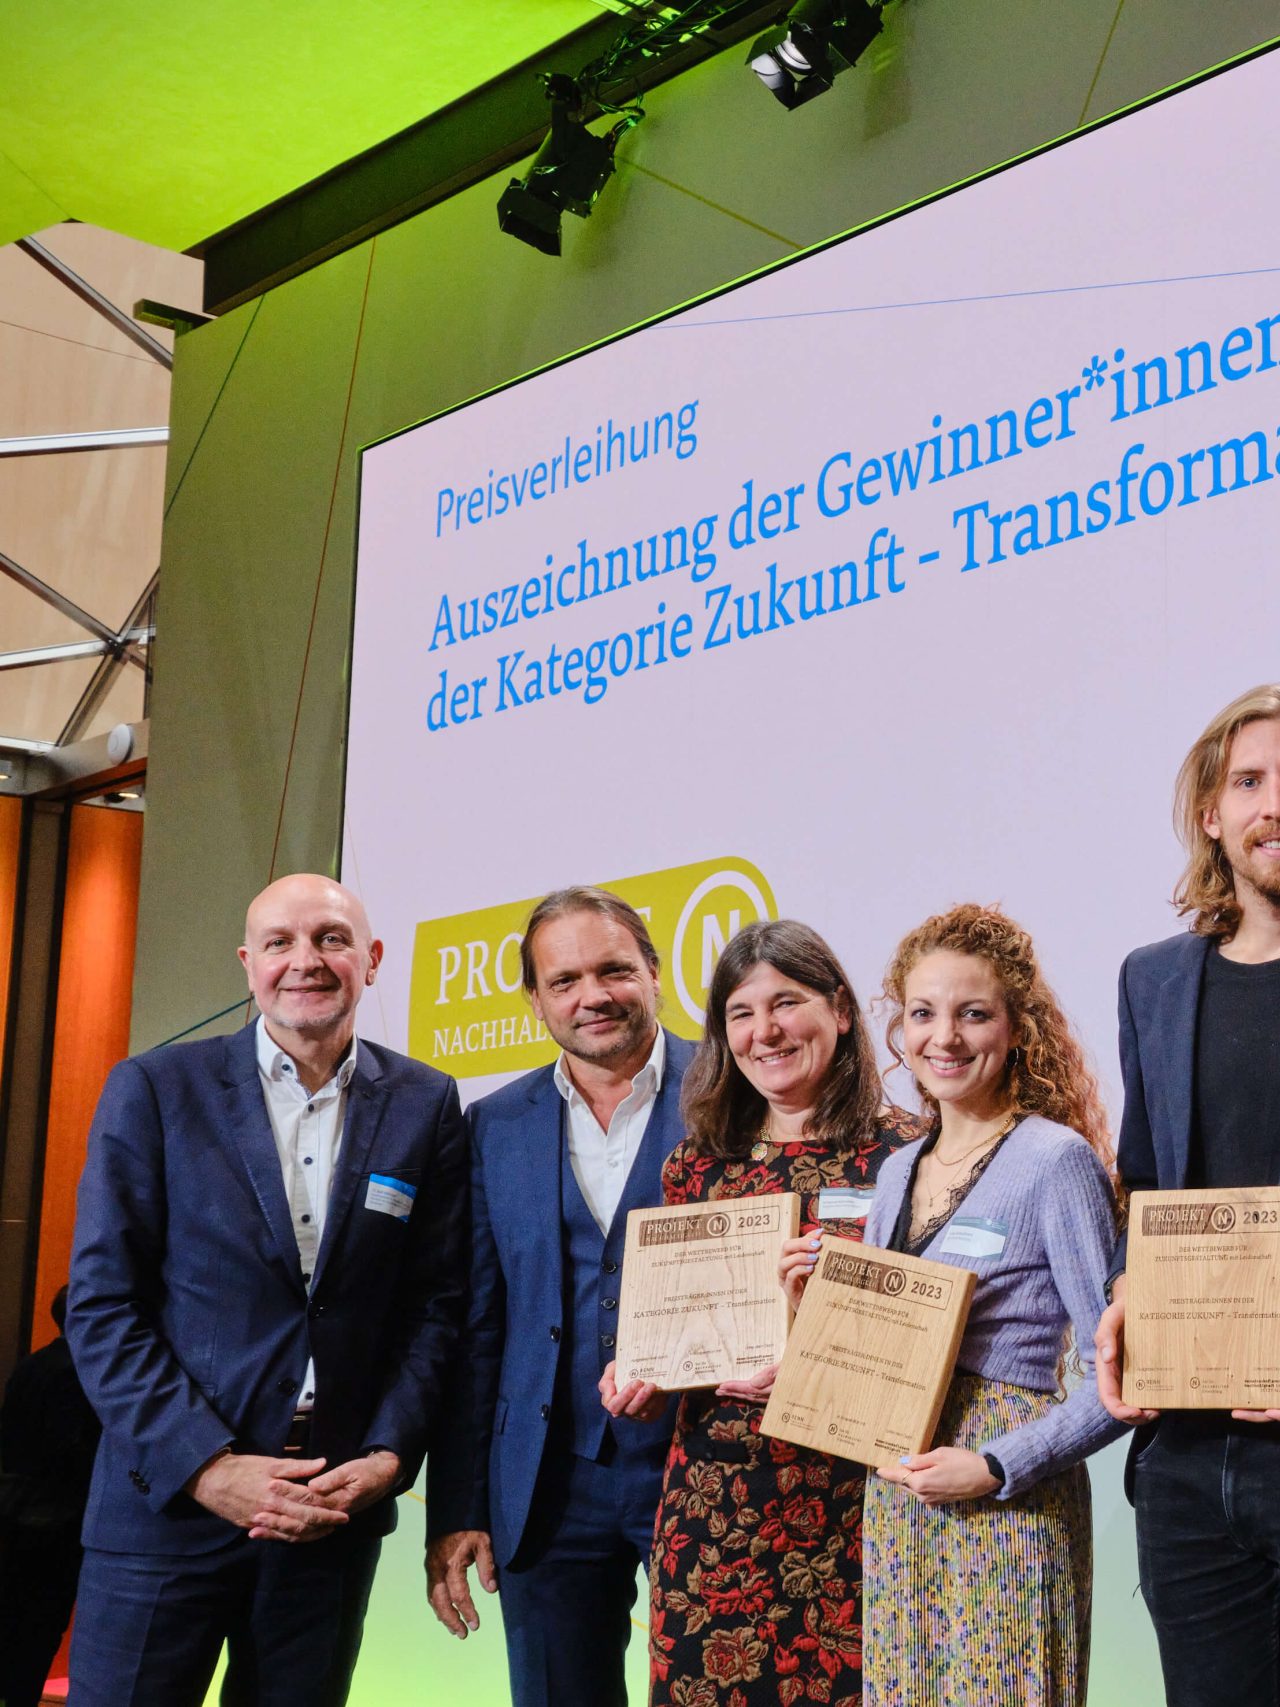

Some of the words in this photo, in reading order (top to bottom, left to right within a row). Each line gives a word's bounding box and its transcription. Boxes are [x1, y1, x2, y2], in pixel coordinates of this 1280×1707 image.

[435, 399, 699, 537] Preisverleihung
[428, 514, 719, 652] Auszeichnung
[728, 479, 805, 550] der
[426, 669, 488, 732] der
[495, 602, 693, 713] Kategorie
[703, 527, 906, 650] Zukunft
[432, 1014, 553, 1058] NACHHAL
[647, 1219, 703, 1234] PROJEKT
[737, 1215, 771, 1228] 2023
[1149, 1209, 1206, 1222] PROJEKT
[1243, 1211, 1278, 1225] 2023
[831, 1257, 882, 1279] PROJEKT
[911, 1281, 943, 1300] 2023
[633, 1307, 680, 1319] KATEGORIE
[681, 1303, 719, 1313] ZUKUNFT
[1138, 1312, 1185, 1320] KATEGORIE
[800, 1351, 841, 1367] KATEGORIE
[841, 1362, 875, 1377] ZUKUNFT
